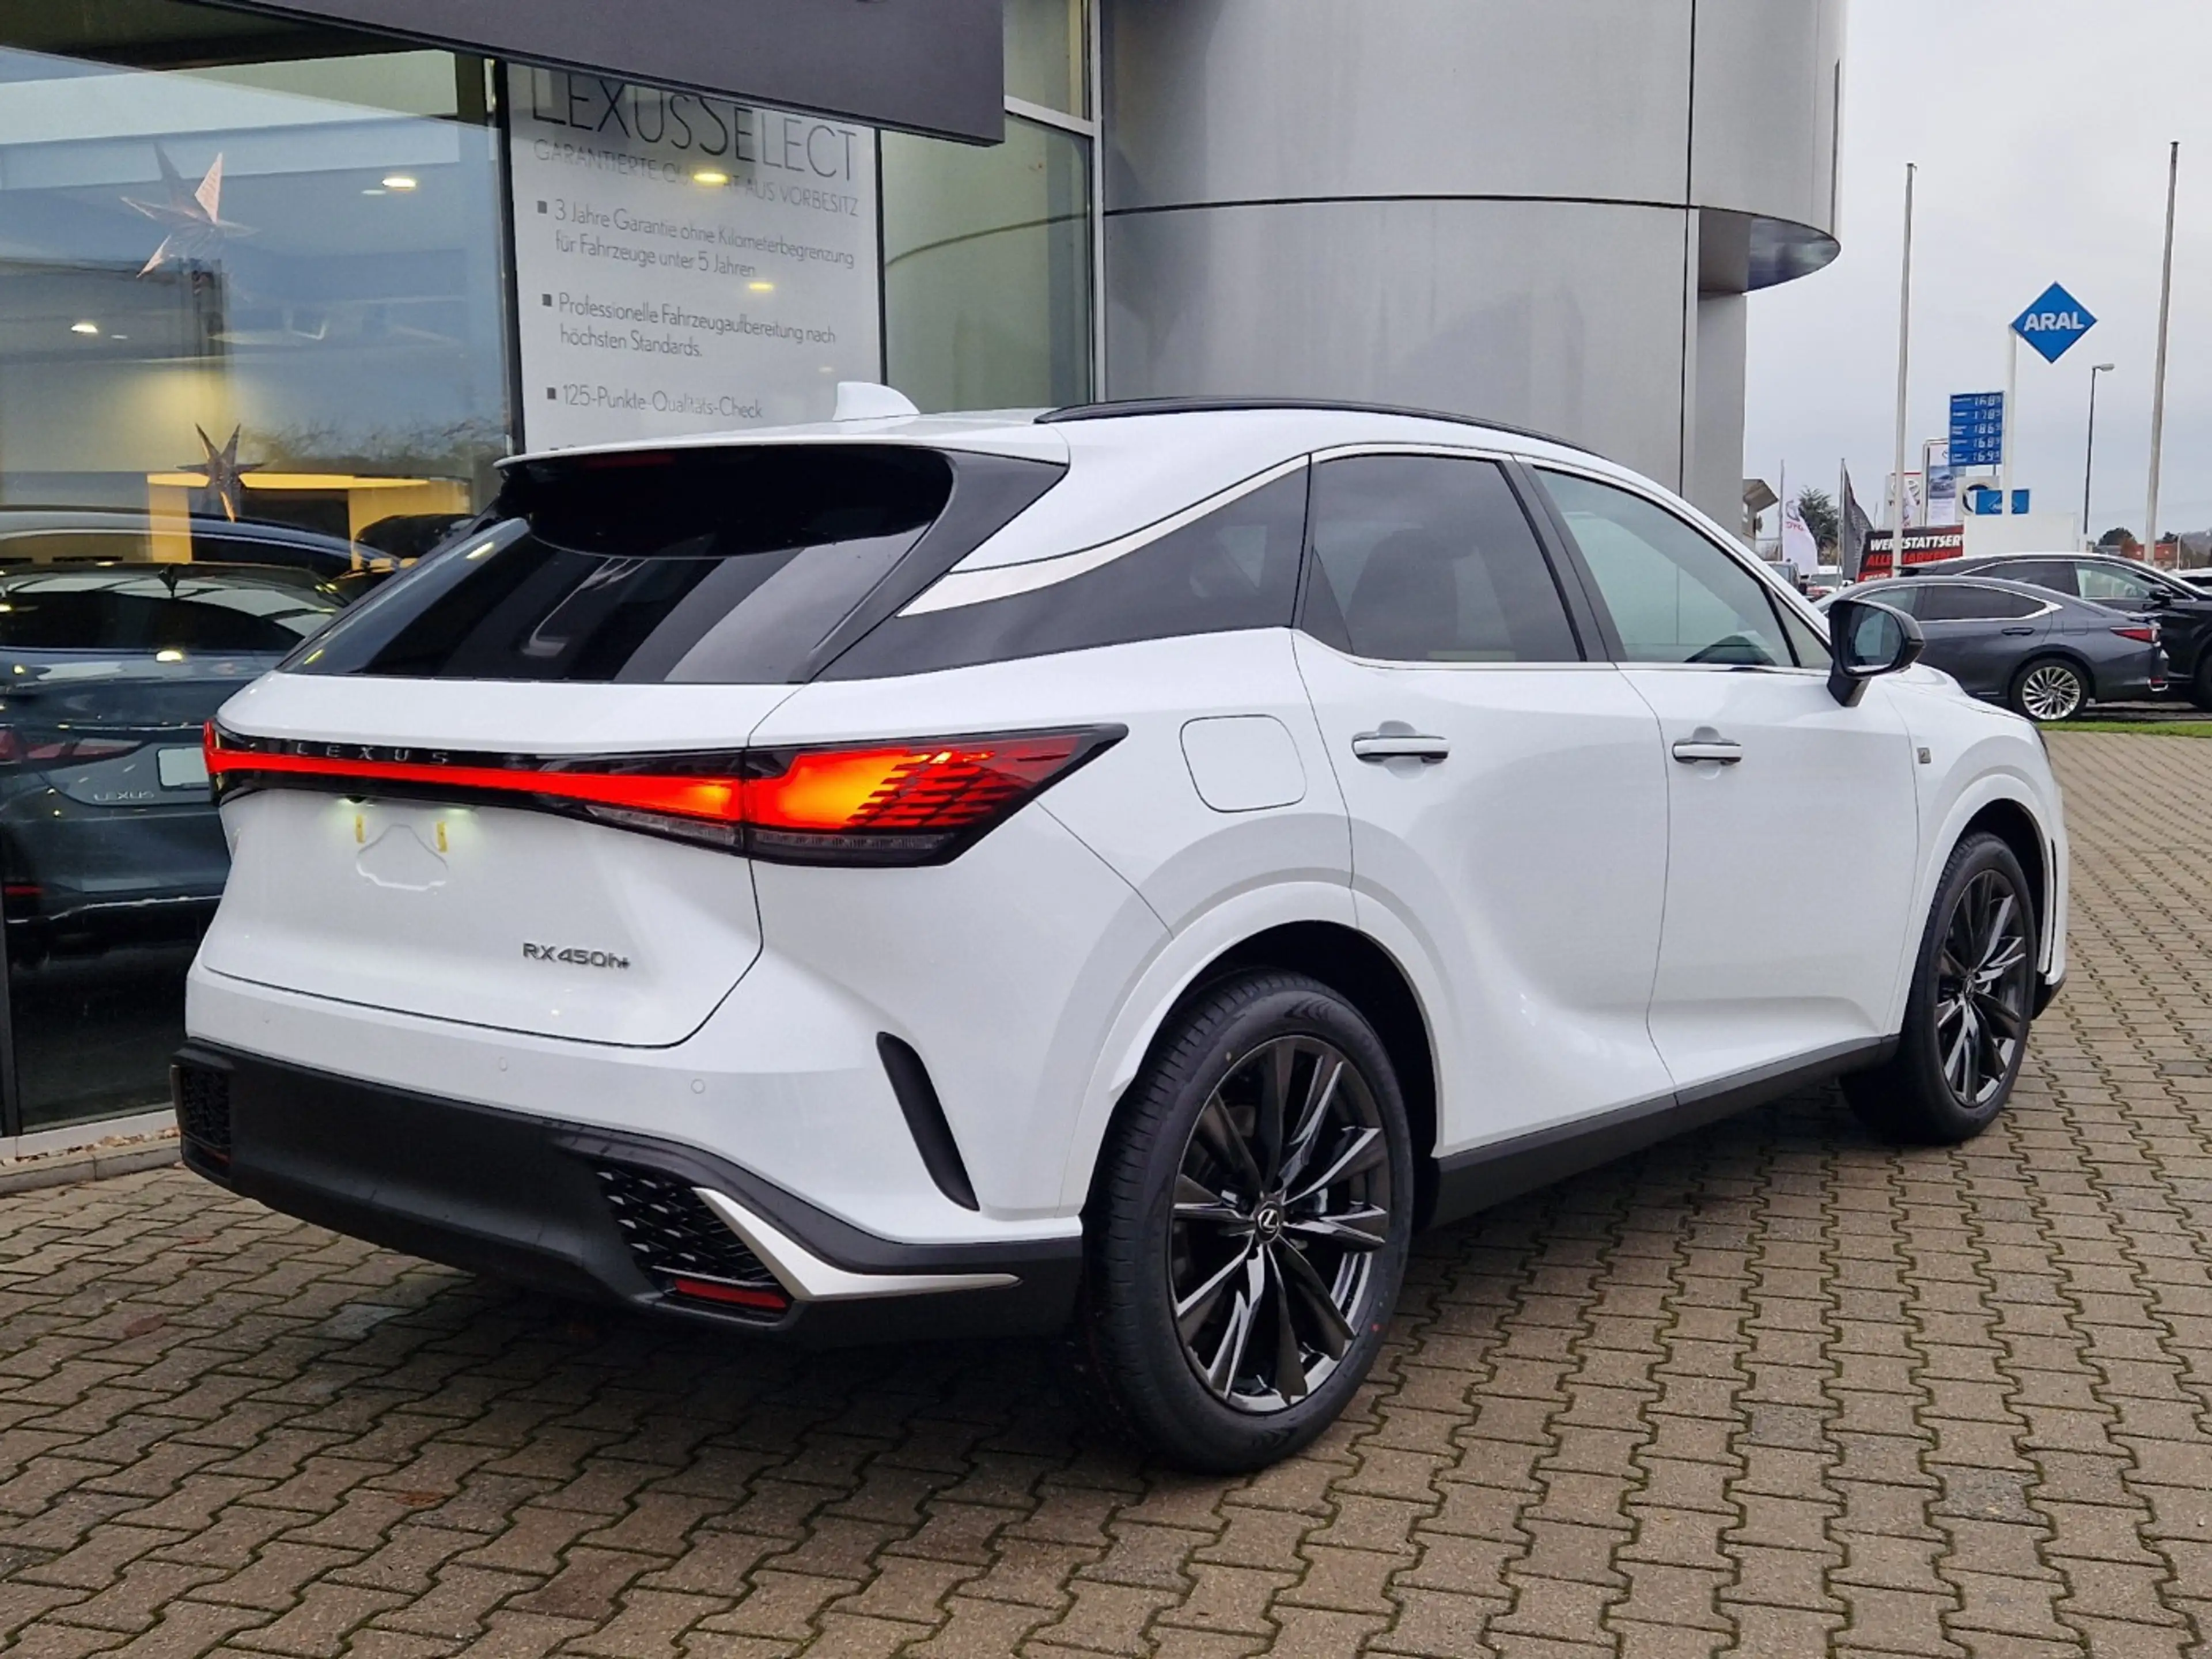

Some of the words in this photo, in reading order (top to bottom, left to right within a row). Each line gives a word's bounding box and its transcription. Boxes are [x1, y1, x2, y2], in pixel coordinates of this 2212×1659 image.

[779, 184, 859, 218] VORBESITZ
[555, 198, 566, 221] 3
[571, 202, 609, 228] Jahre
[613, 208, 677, 238] Garantie
[680, 224, 715, 244] ohne
[718, 226, 854, 269] Kilometerbegrenzung
[555, 229, 576, 252] für
[579, 233, 656, 268] Fahrzeuge
[659, 251, 694, 269] unter
[698, 251, 709, 271] 5
[714, 253, 755, 277] Jahren
[559, 291, 658, 324] Professionelle
[662, 303, 804, 344] Fahrzeugaufbereitung
[806, 325, 835, 344] nach
[2024, 311, 2085, 332] ARAL
[560, 323, 627, 349] höchsten
[631, 329, 703, 357] Standards.
[297, 742, 449, 766] LEXUS
